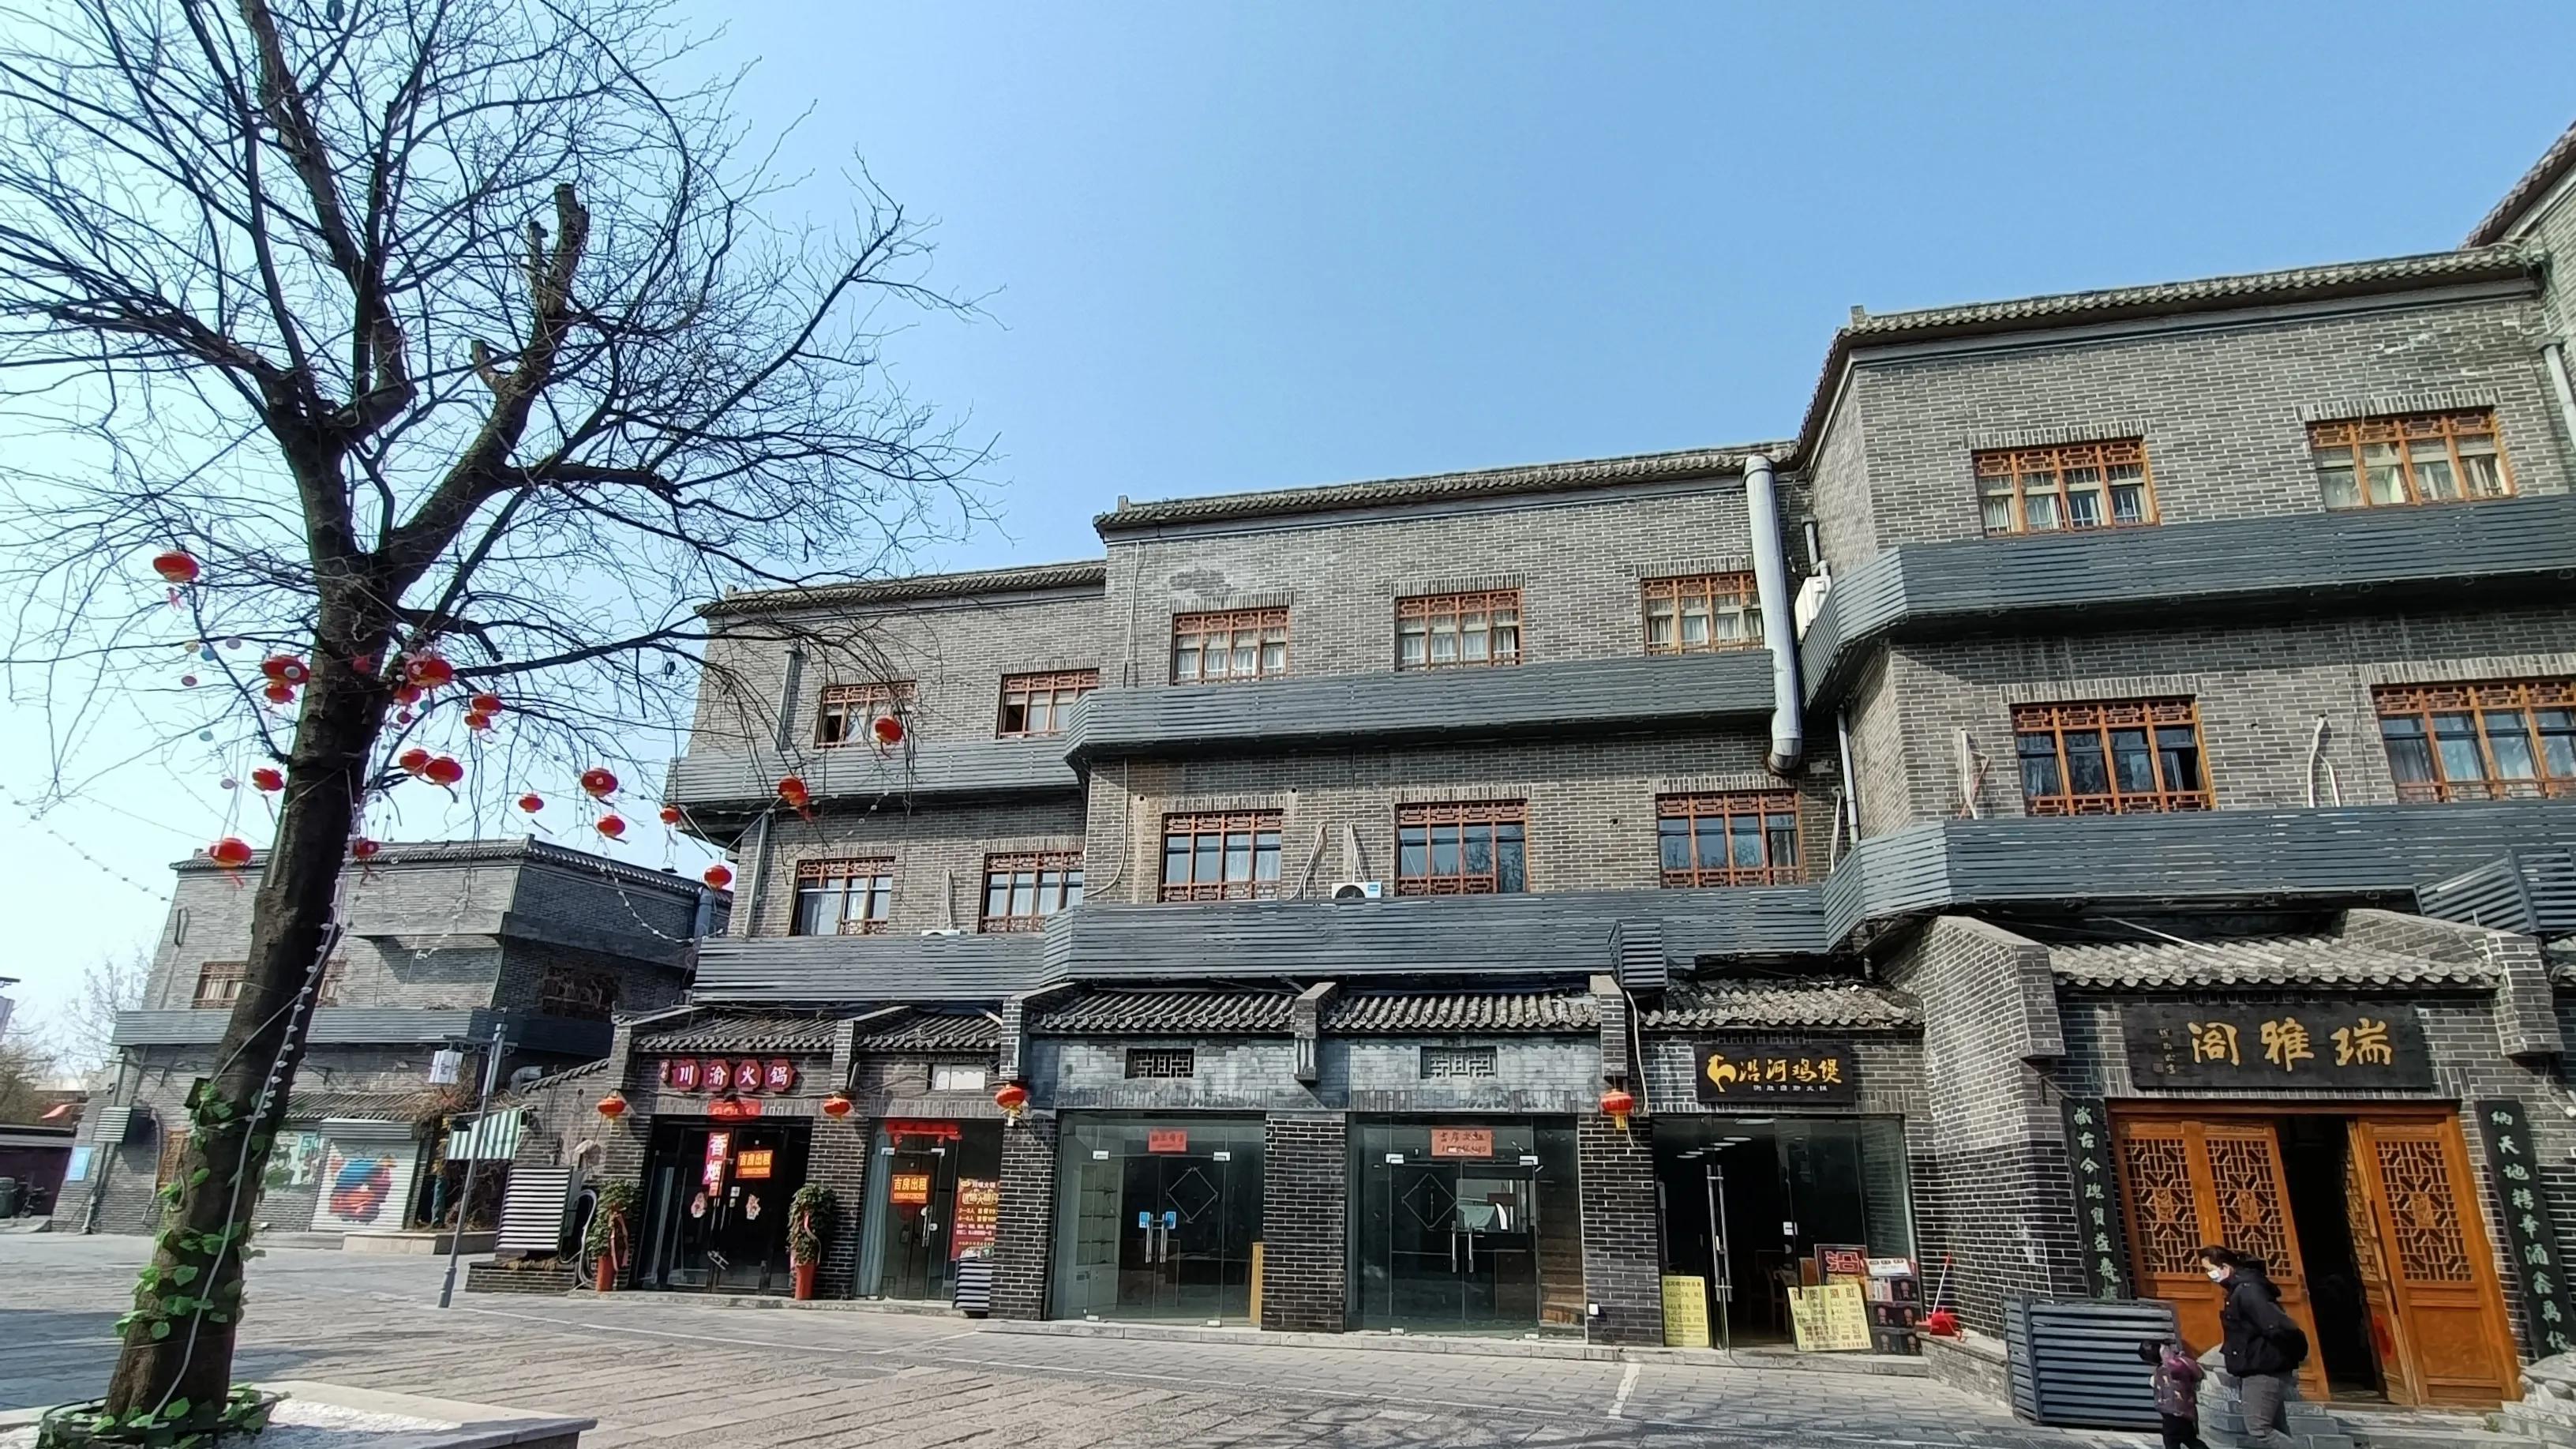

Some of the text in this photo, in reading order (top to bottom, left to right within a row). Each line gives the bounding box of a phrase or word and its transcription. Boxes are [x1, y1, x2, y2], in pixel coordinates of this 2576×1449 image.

[679, 1065, 788, 1085] 川渝火锅
[1738, 1058, 1842, 1083] 沿河鸡煲
[739, 1152, 771, 1166] 吉房出租
[894, 1177, 927, 1191] 吉房出租
